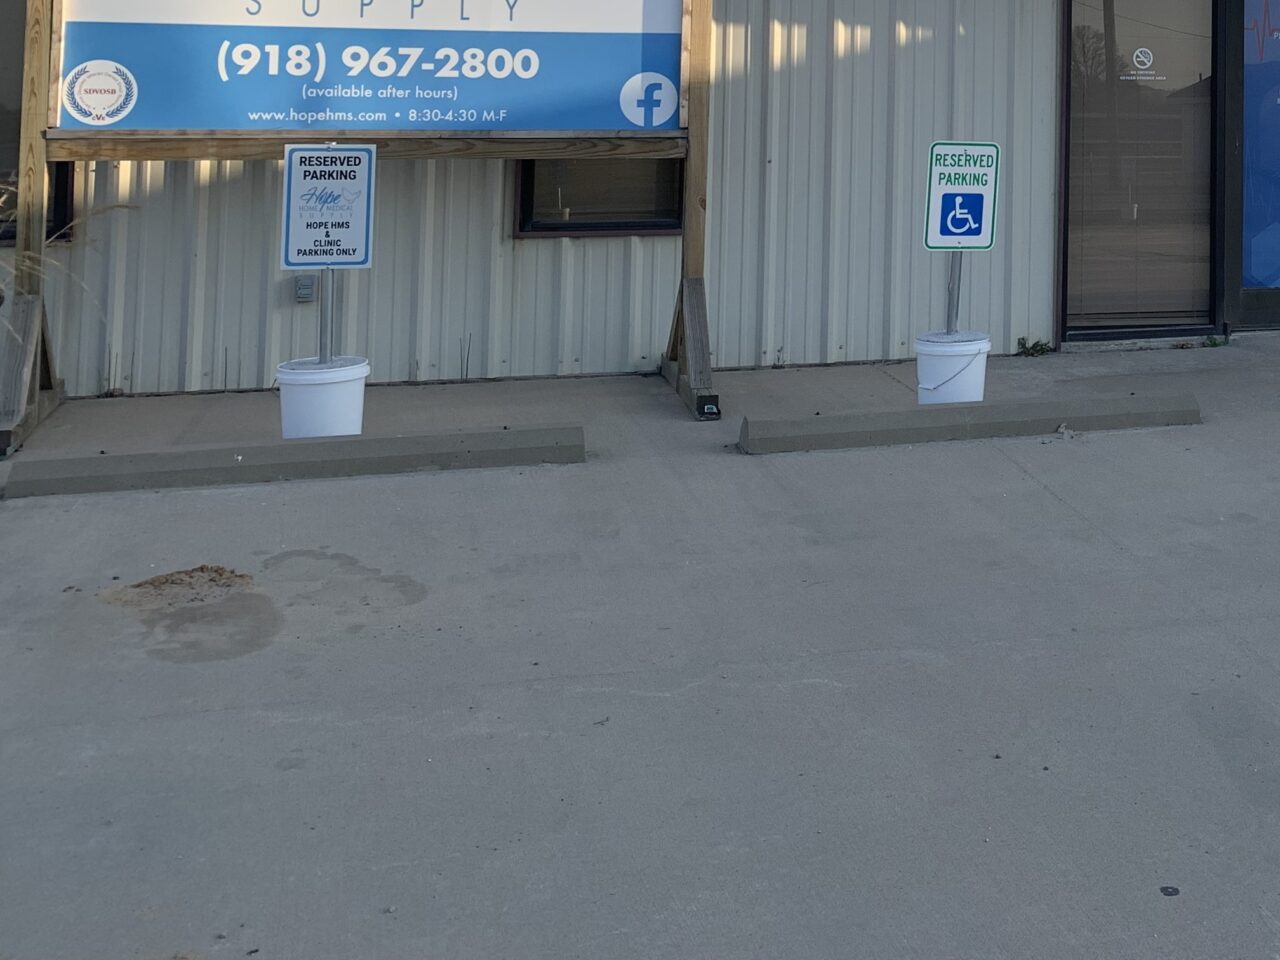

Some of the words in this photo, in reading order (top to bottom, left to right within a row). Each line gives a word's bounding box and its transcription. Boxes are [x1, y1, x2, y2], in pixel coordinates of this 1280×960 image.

[217, 40, 327, 84] (918)
[341, 46, 541, 80] 967-2800
[302, 85, 373, 100] (available
[377, 86, 411, 98] after
[415, 86, 458, 101] hours)
[248, 108, 387, 125] www.hopehms.com
[408, 109, 477, 123] 8:30-4:30
[482, 110, 507, 123] M-F
[299, 156, 362, 166] RESERVED
[935, 154, 994, 168] RESERVED
[303, 170, 357, 180] PARKING
[938, 172, 988, 186] PARKING
[300, 186, 342, 212] Hope
[330, 221, 350, 229] HMS
[324, 230, 330, 238] &
[313, 239, 342, 248] CLINIC
[297, 248, 334, 256] PARKING
[336, 248, 357, 256] ONLY
